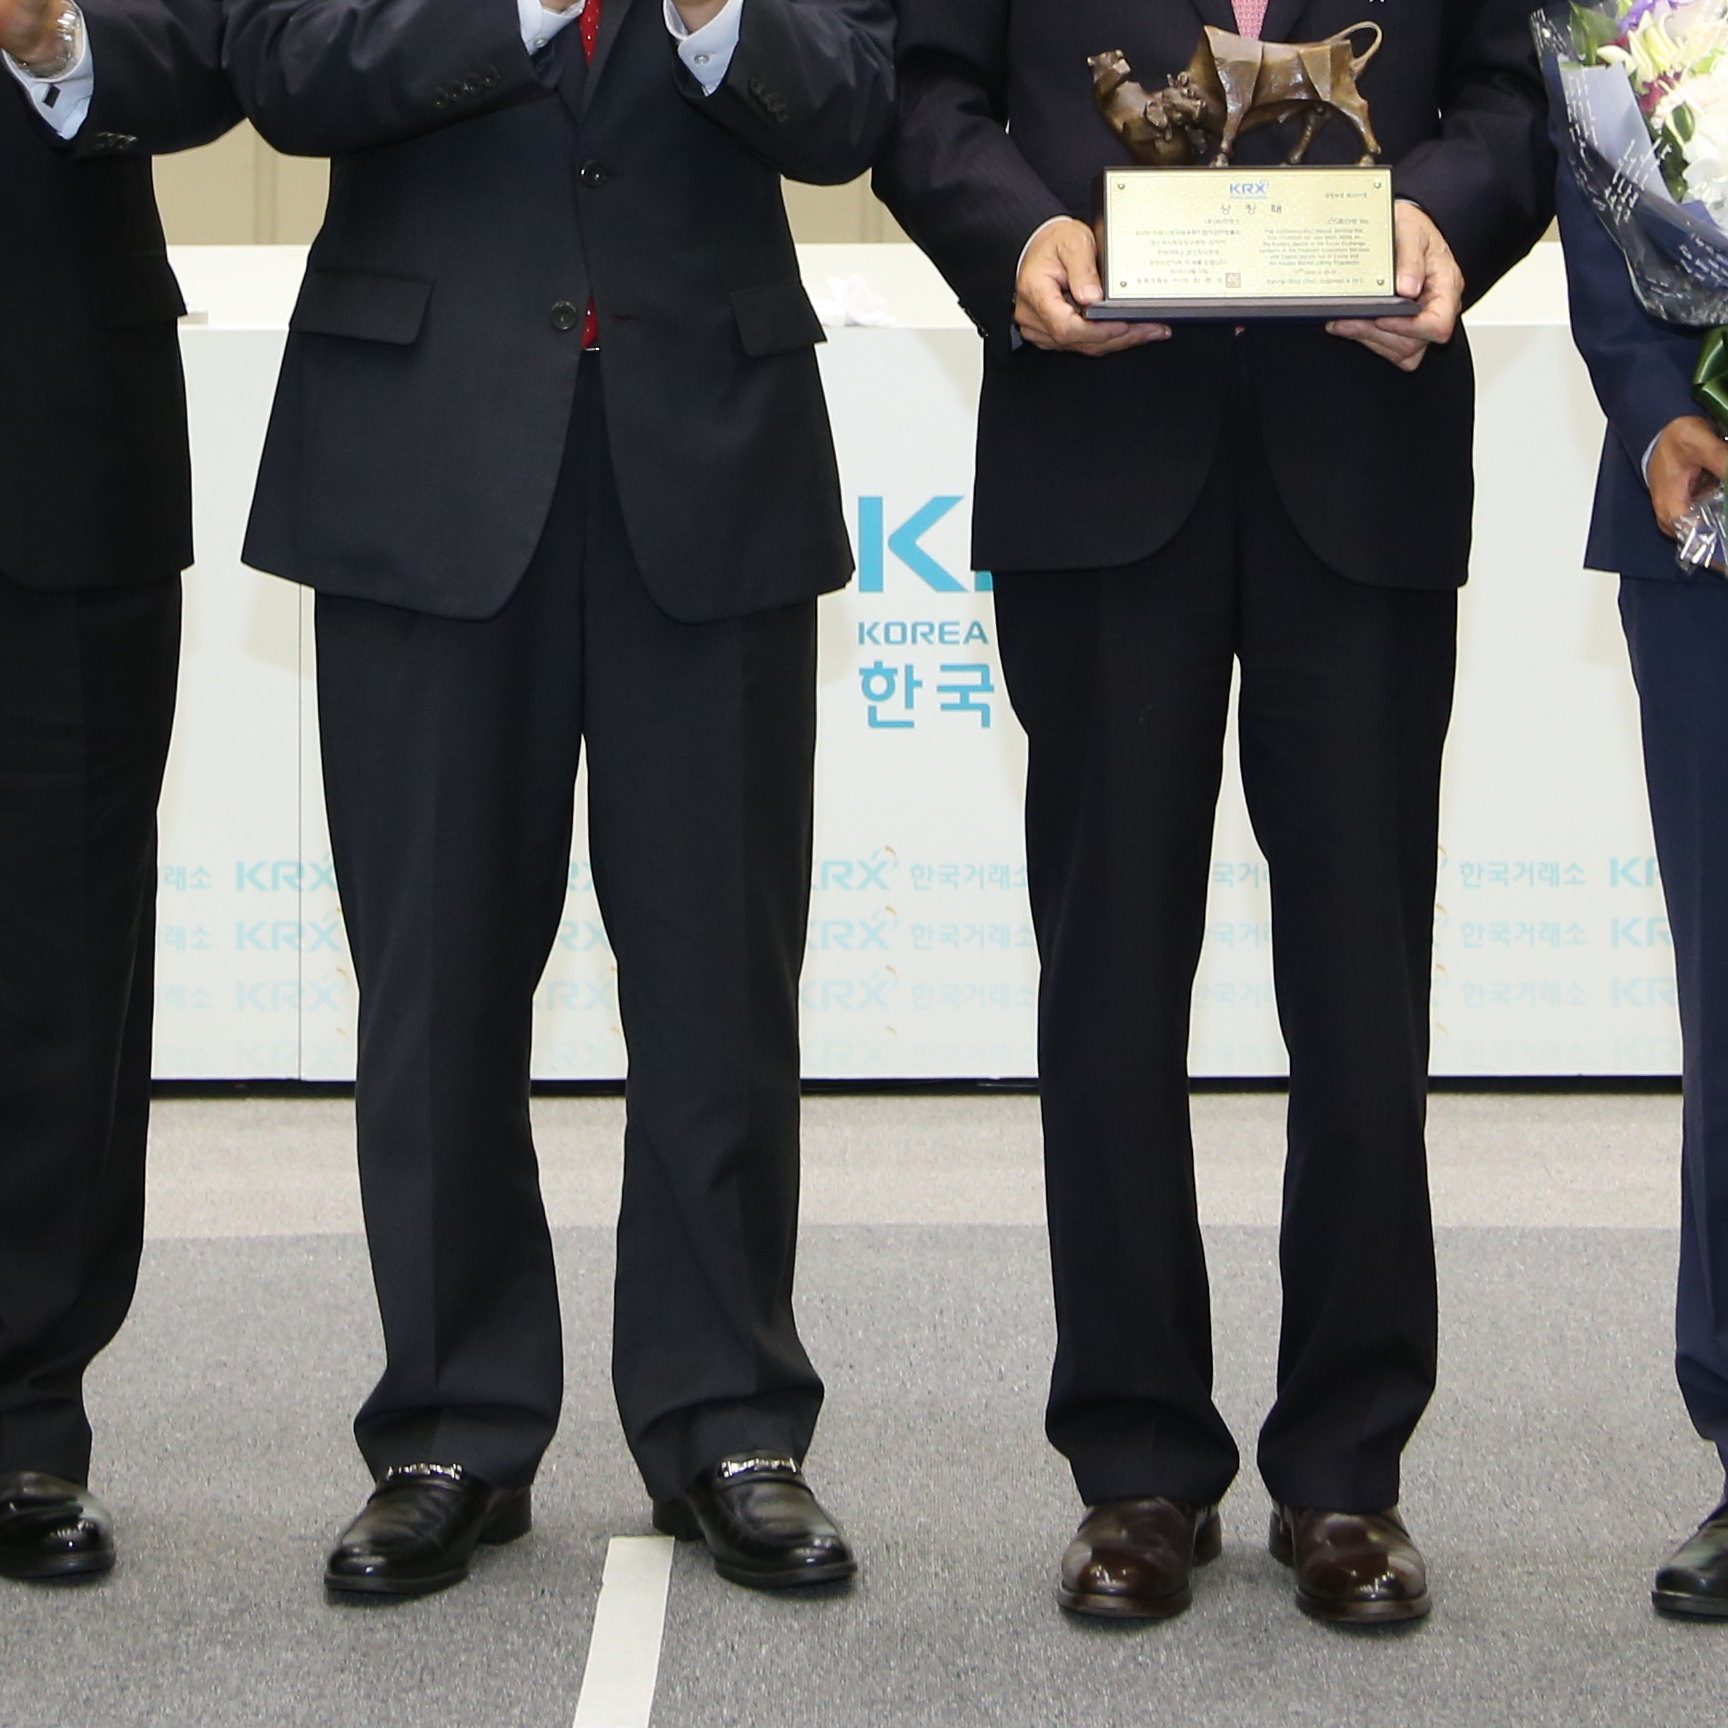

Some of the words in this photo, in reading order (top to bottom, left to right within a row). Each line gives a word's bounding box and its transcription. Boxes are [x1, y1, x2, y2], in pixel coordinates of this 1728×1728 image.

[1229, 183, 1267, 195] KRX
[858, 620, 990, 645] KOREA
[1460, 860, 1586, 889] 한국거래소
[236, 920, 341, 952] KRX
[1460, 920, 1587, 949] 한국거래소
[1610, 917, 1674, 948] KR
